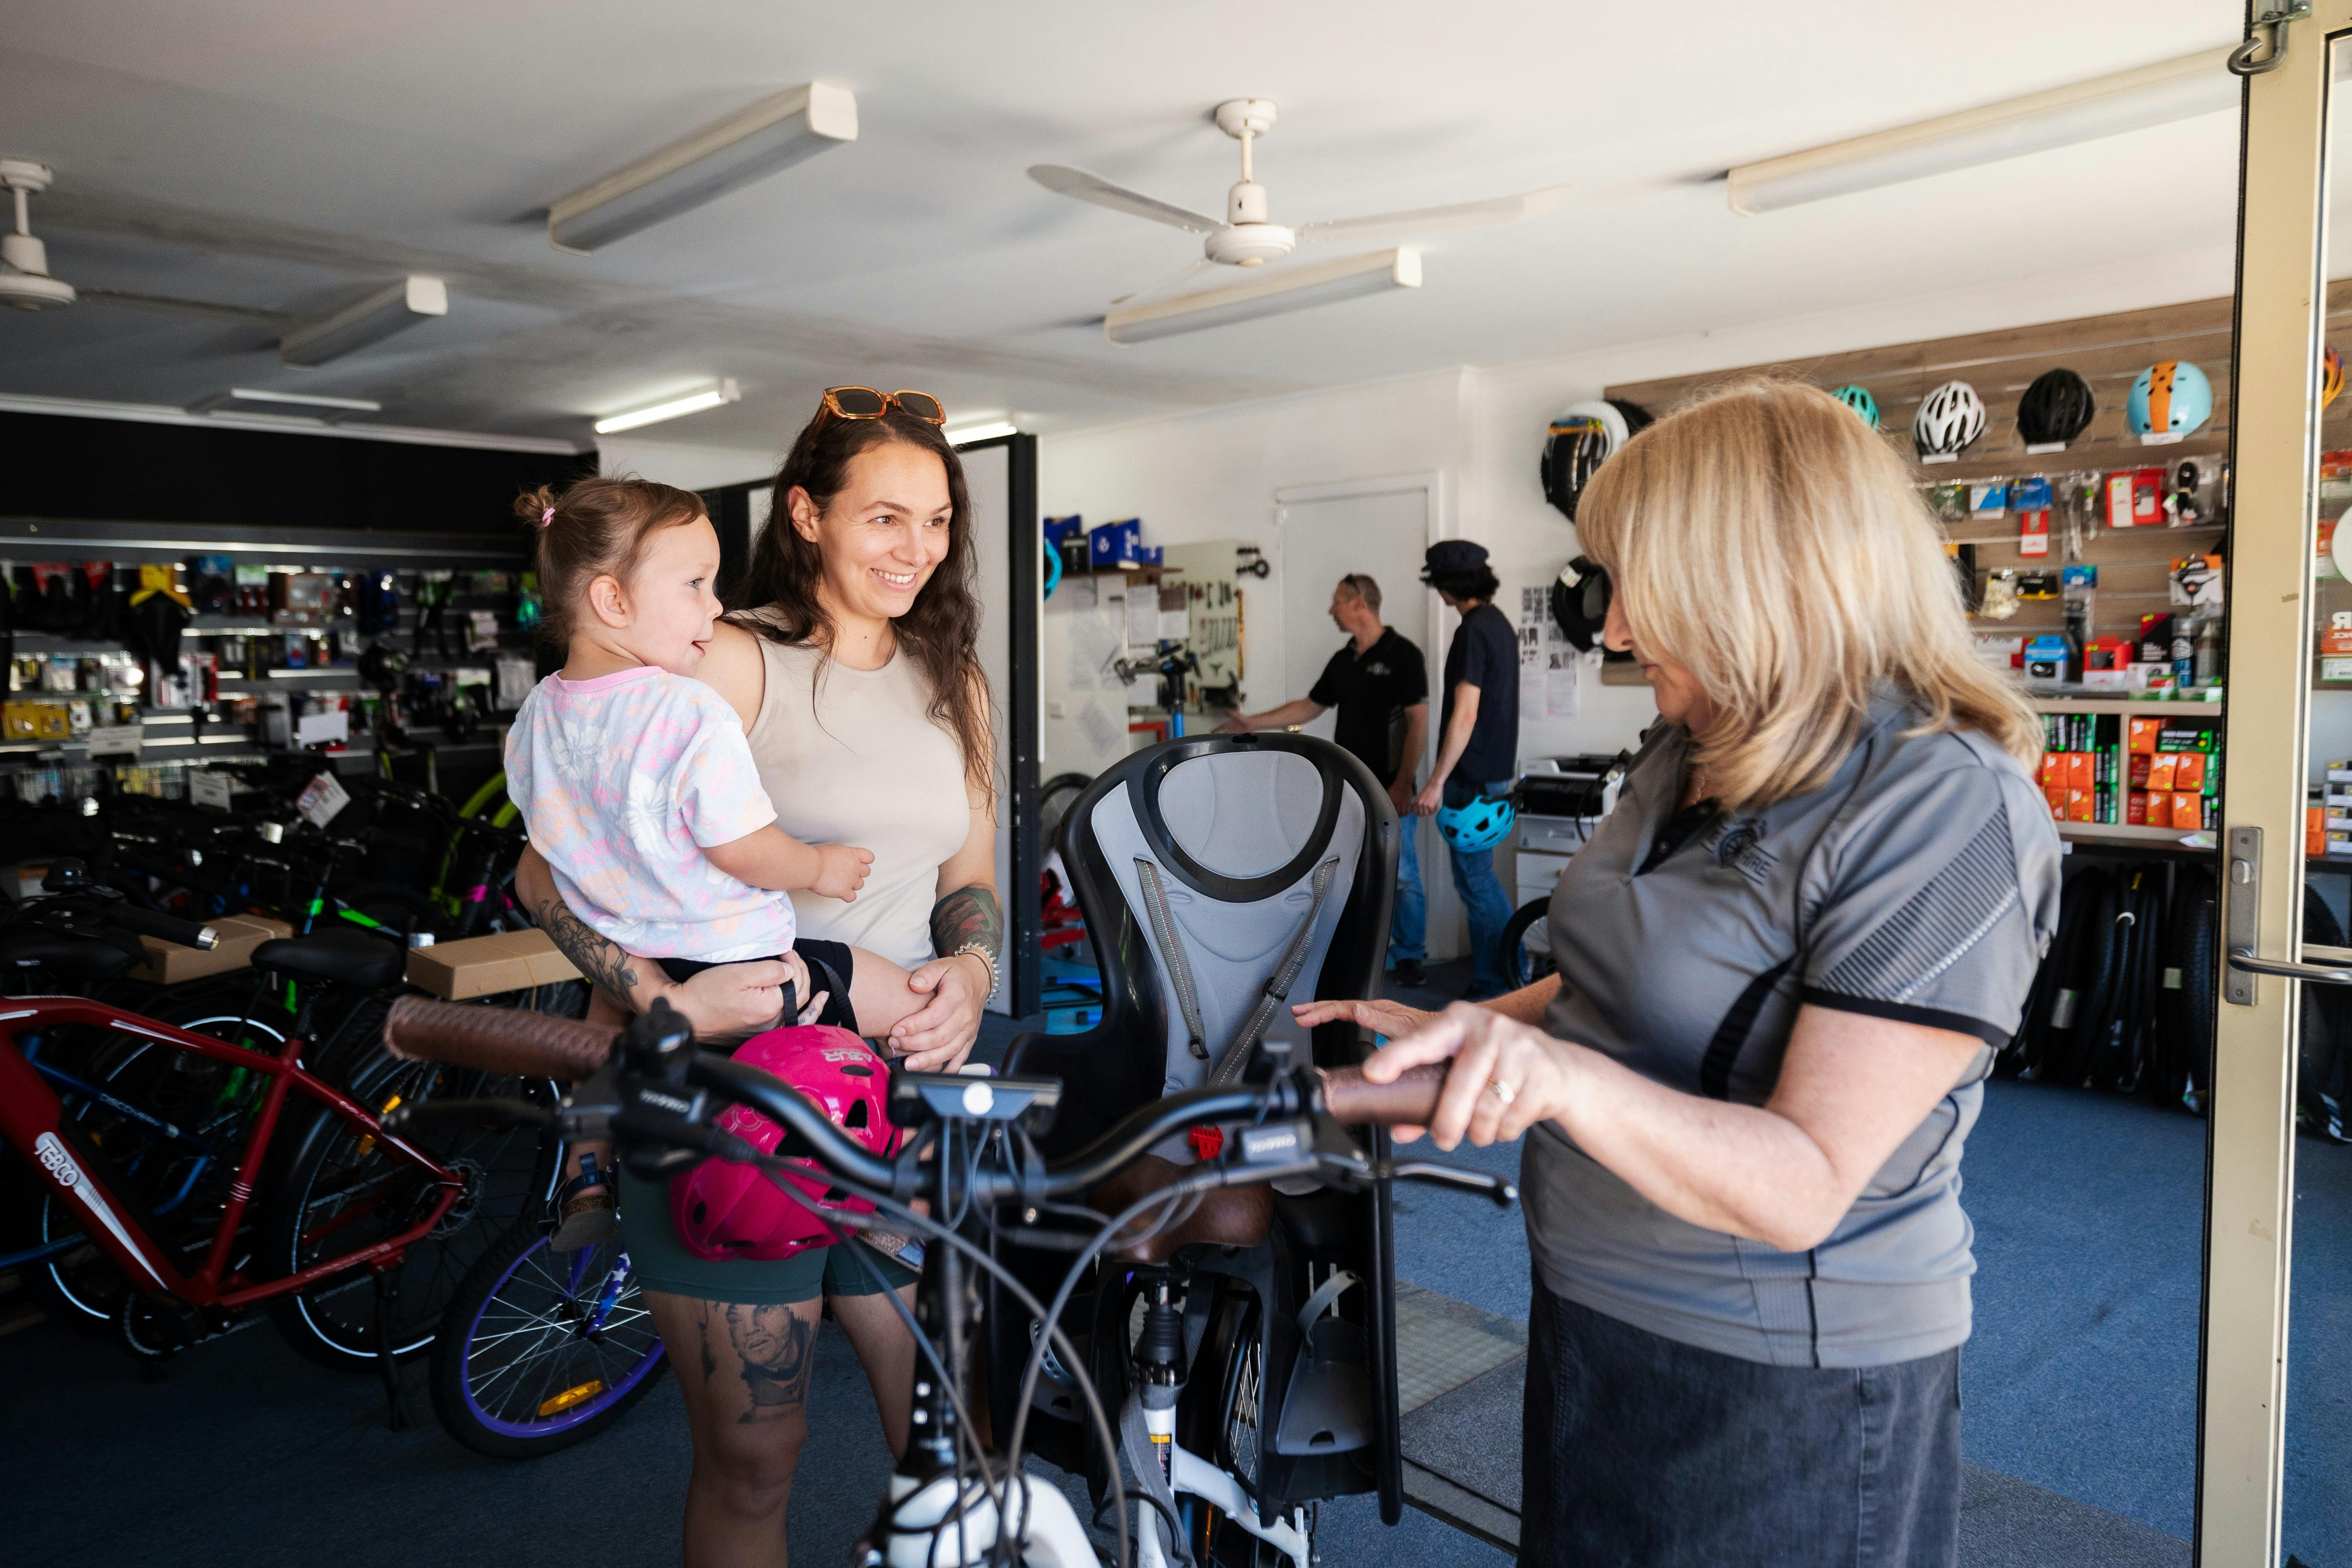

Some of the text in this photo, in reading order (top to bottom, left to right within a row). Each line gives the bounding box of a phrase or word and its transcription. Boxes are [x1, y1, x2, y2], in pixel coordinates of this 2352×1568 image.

[1741, 853, 1772, 878] HIRE
[825, 1051, 872, 1063] AZUR
[34, 1138, 80, 1186] TEBCO
